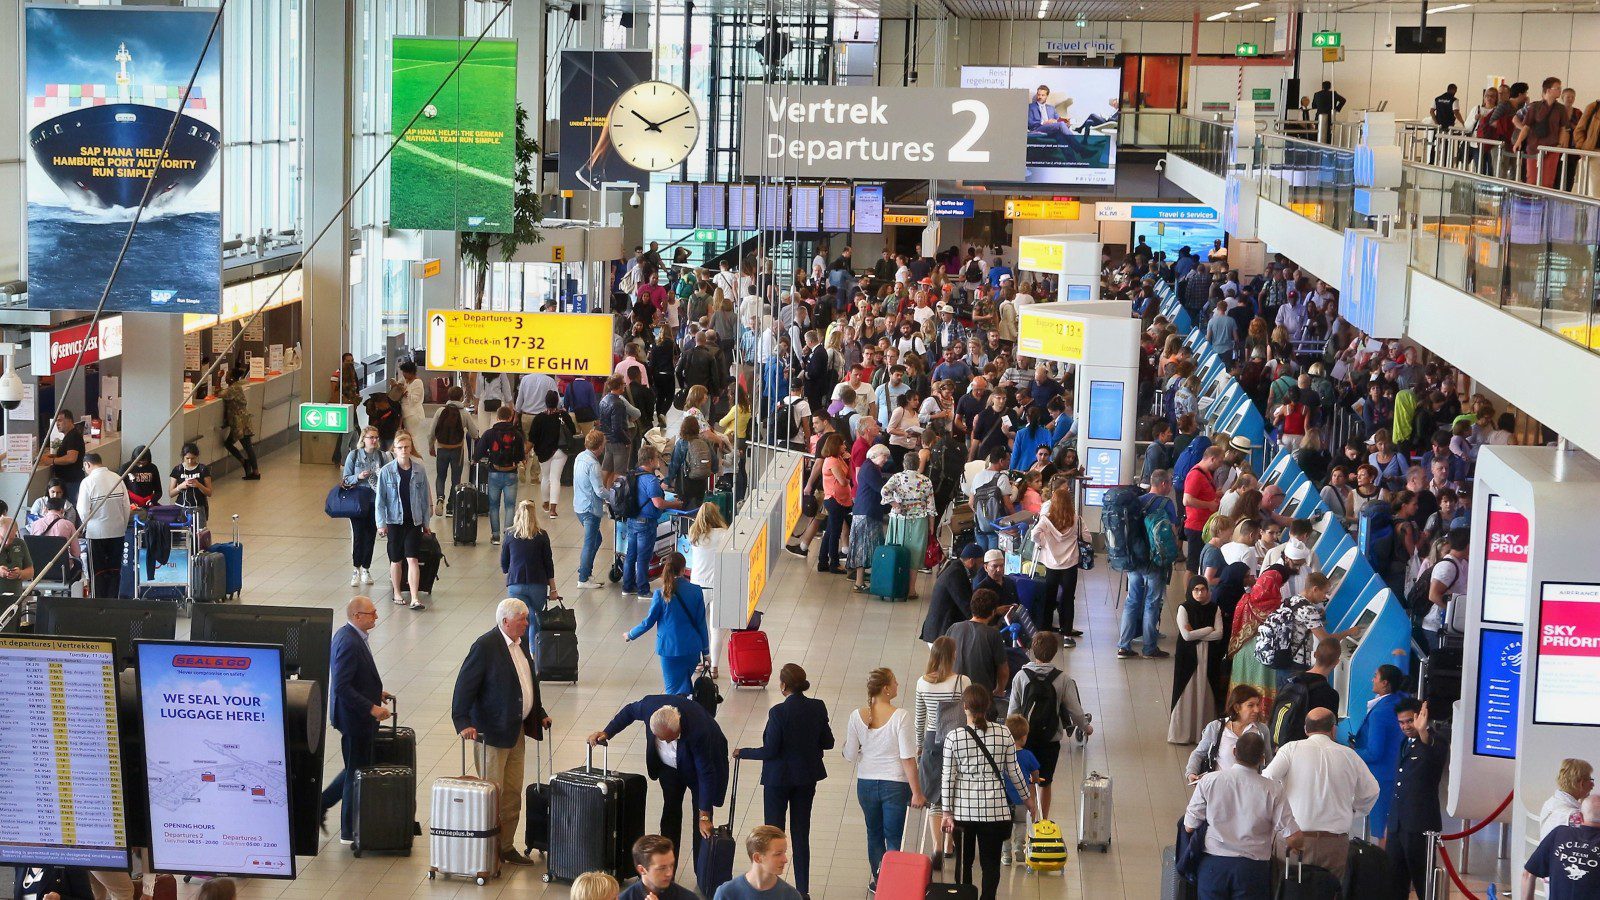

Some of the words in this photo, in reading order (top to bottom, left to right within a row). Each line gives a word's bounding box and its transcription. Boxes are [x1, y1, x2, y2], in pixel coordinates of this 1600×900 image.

[1046, 40, 1080, 50] Travel
[1084, 42, 1115, 51] Clinic
[988, 68, 1007, 76] Reist
[966, 78, 1005, 86] regelmatig
[766, 96, 889, 125] Vertrek
[948, 98, 990, 163] 2
[80, 146, 101, 156] SAP
[103, 147, 133, 157] HANA
[136, 148, 169, 158] HELPS
[766, 133, 935, 166] Departures
[53, 156, 105, 167] HAMBURG
[108, 158, 135, 168] PORT
[137, 158, 196, 170] AUTHORITY
[92, 167, 114, 177] RUN
[555, 248, 562, 260] E
[152, 291, 172, 302] SAP
[463, 313, 512, 323] Departures
[515, 317, 523, 329] 3
[463, 336, 501, 346] Check-in
[503, 336, 545, 350] 17-32
[58, 340, 82, 359] SERVICE
[462, 356, 488, 366] Gates
[1491, 533, 1520, 544] SKY
[1543, 624, 1576, 636] SKY
[8, 640, 51, 648] departures
[57, 642, 100, 650] Vertrekken
[176, 657, 212, 665] SEAL
[226, 659, 247, 667] GO
[163, 693, 185, 704] WE
[188, 694, 220, 706] SEAL
[223, 696, 261, 707] YOUR
[160, 708, 223, 720] LUGGAGE
[226, 711, 265, 722] HERE!
[1554, 841, 1589, 857] UNCLE
[1560, 854, 1598, 868] POLO
